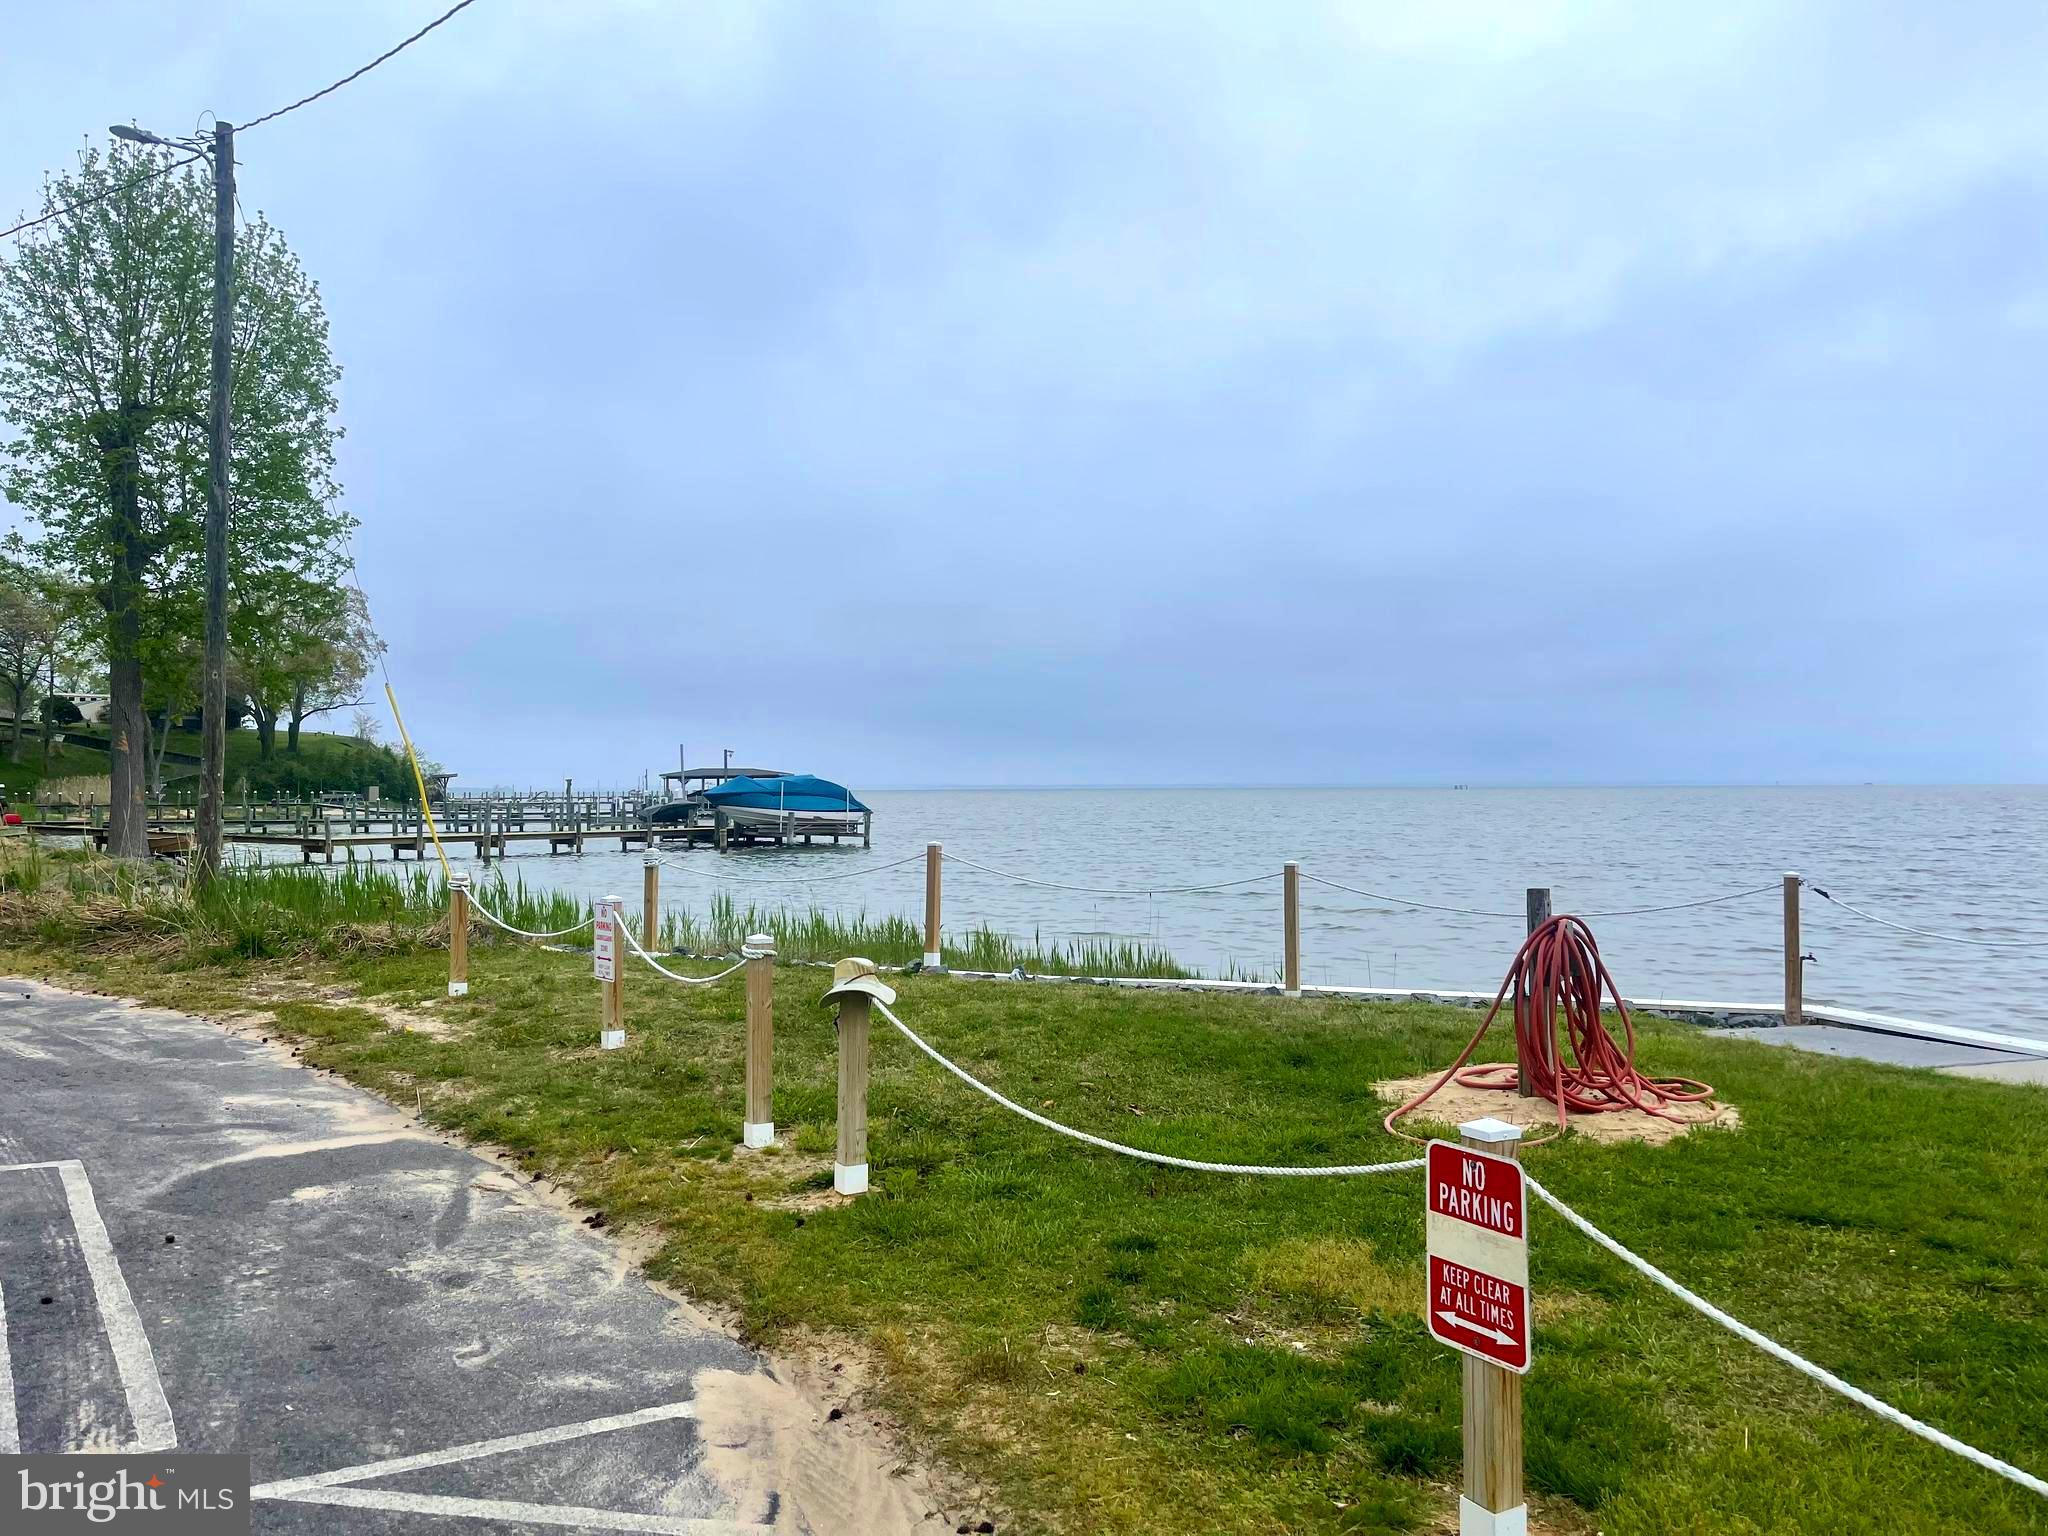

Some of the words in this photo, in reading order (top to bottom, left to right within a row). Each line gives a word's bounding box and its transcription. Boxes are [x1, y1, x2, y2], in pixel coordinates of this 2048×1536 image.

[1462, 1158, 1486, 1191] NO
[1439, 1182, 1514, 1232] PARKING
[1443, 1264, 1470, 1290] KEEP
[1474, 1275, 1510, 1306] CLEAR
[1440, 1285, 1452, 1307] AT
[1456, 1291, 1476, 1317] ALL
[1480, 1299, 1514, 1331] TIMES
